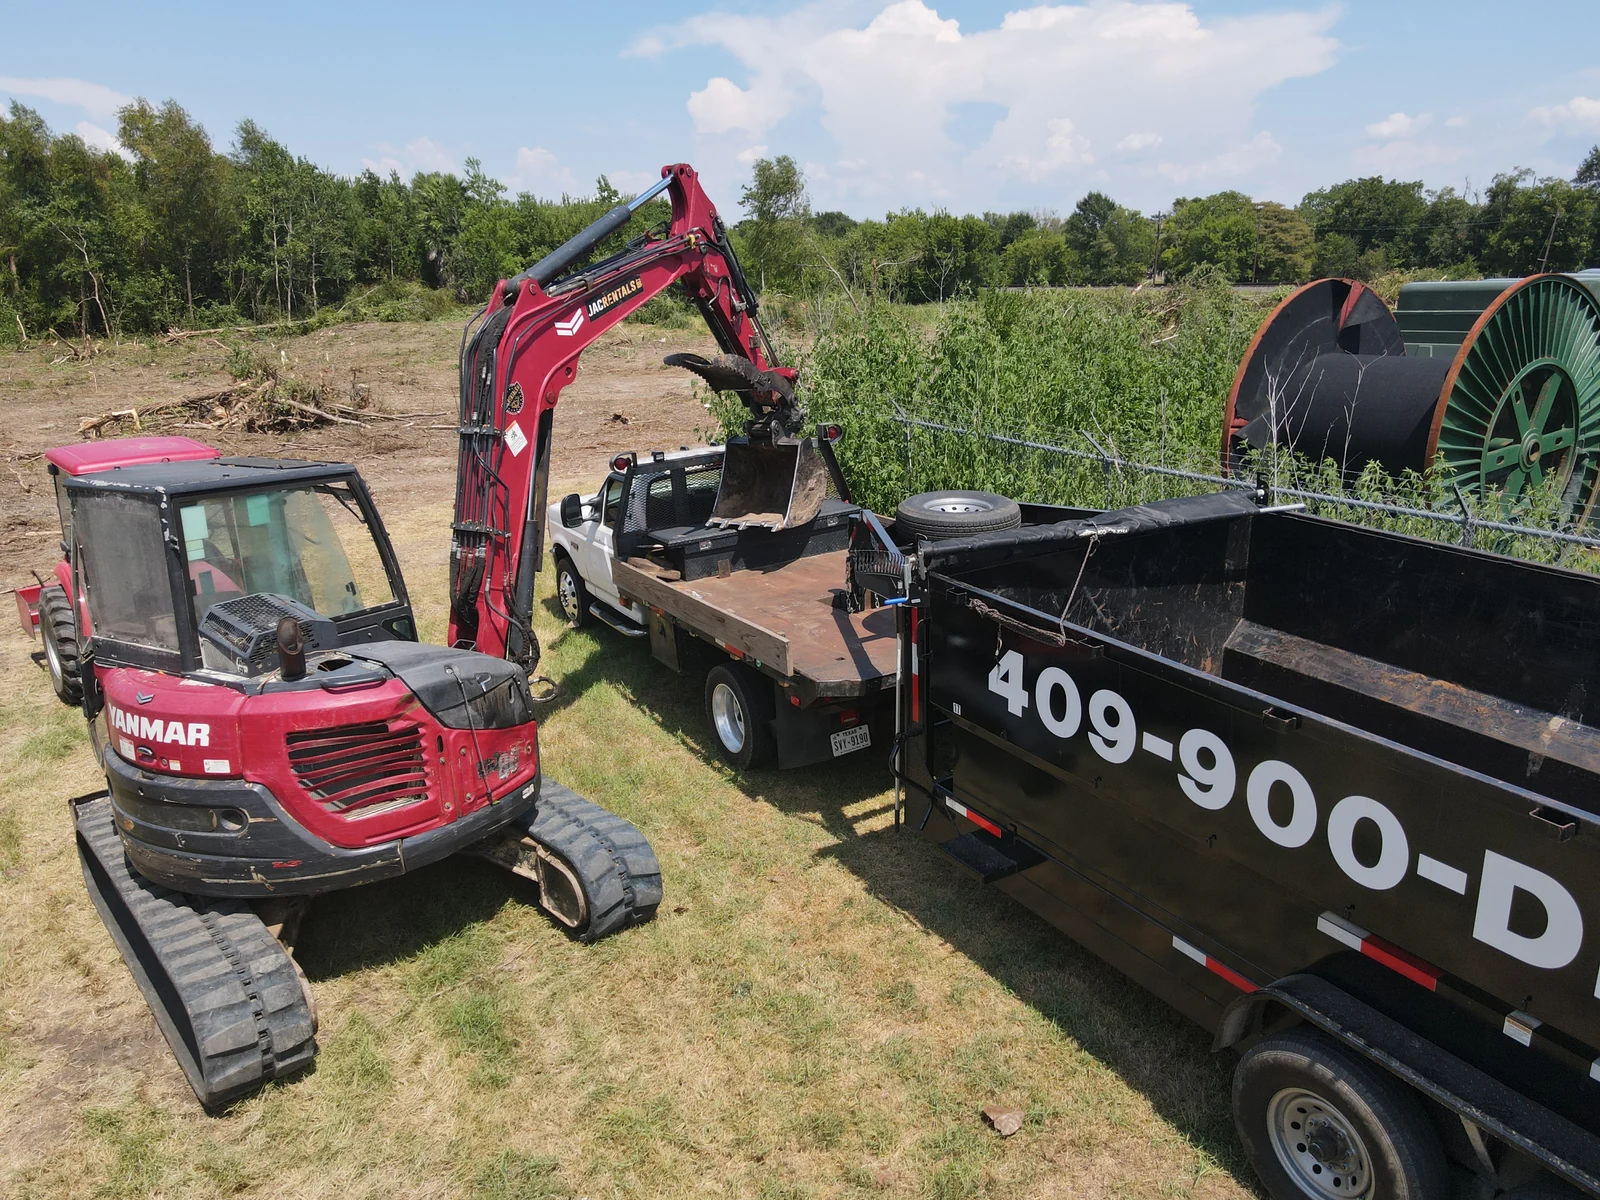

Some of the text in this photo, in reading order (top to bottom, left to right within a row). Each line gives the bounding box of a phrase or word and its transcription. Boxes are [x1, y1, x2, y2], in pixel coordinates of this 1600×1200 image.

[588, 279, 637, 317] JACRENTALS
[108, 702, 210, 747] YANMAR
[842, 729, 857, 737] TEXAS
[988, 650, 1600, 999] 409-900-D
